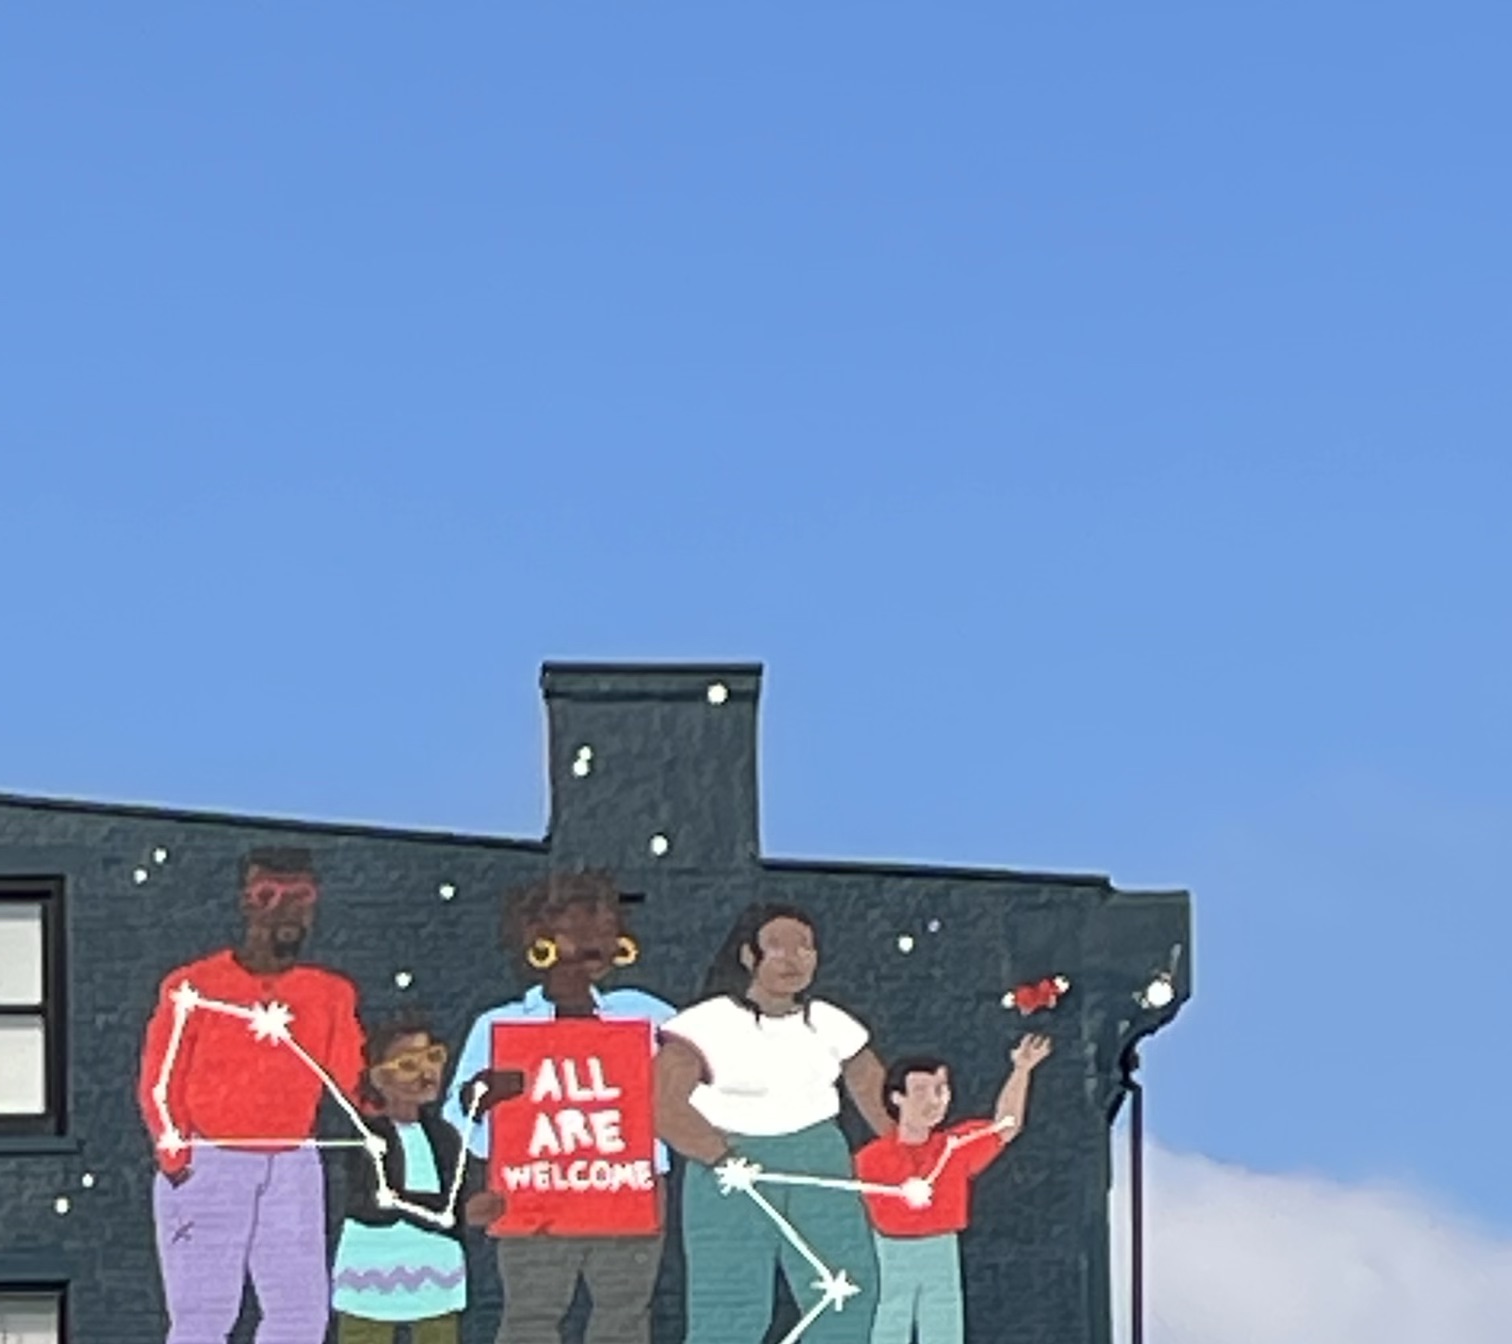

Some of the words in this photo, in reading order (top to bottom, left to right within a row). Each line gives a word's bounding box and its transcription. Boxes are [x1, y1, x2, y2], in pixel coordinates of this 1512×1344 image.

[531, 1056, 622, 1103] ALL
[529, 1108, 626, 1157] ARE
[501, 1160, 655, 1192] WELCOME
